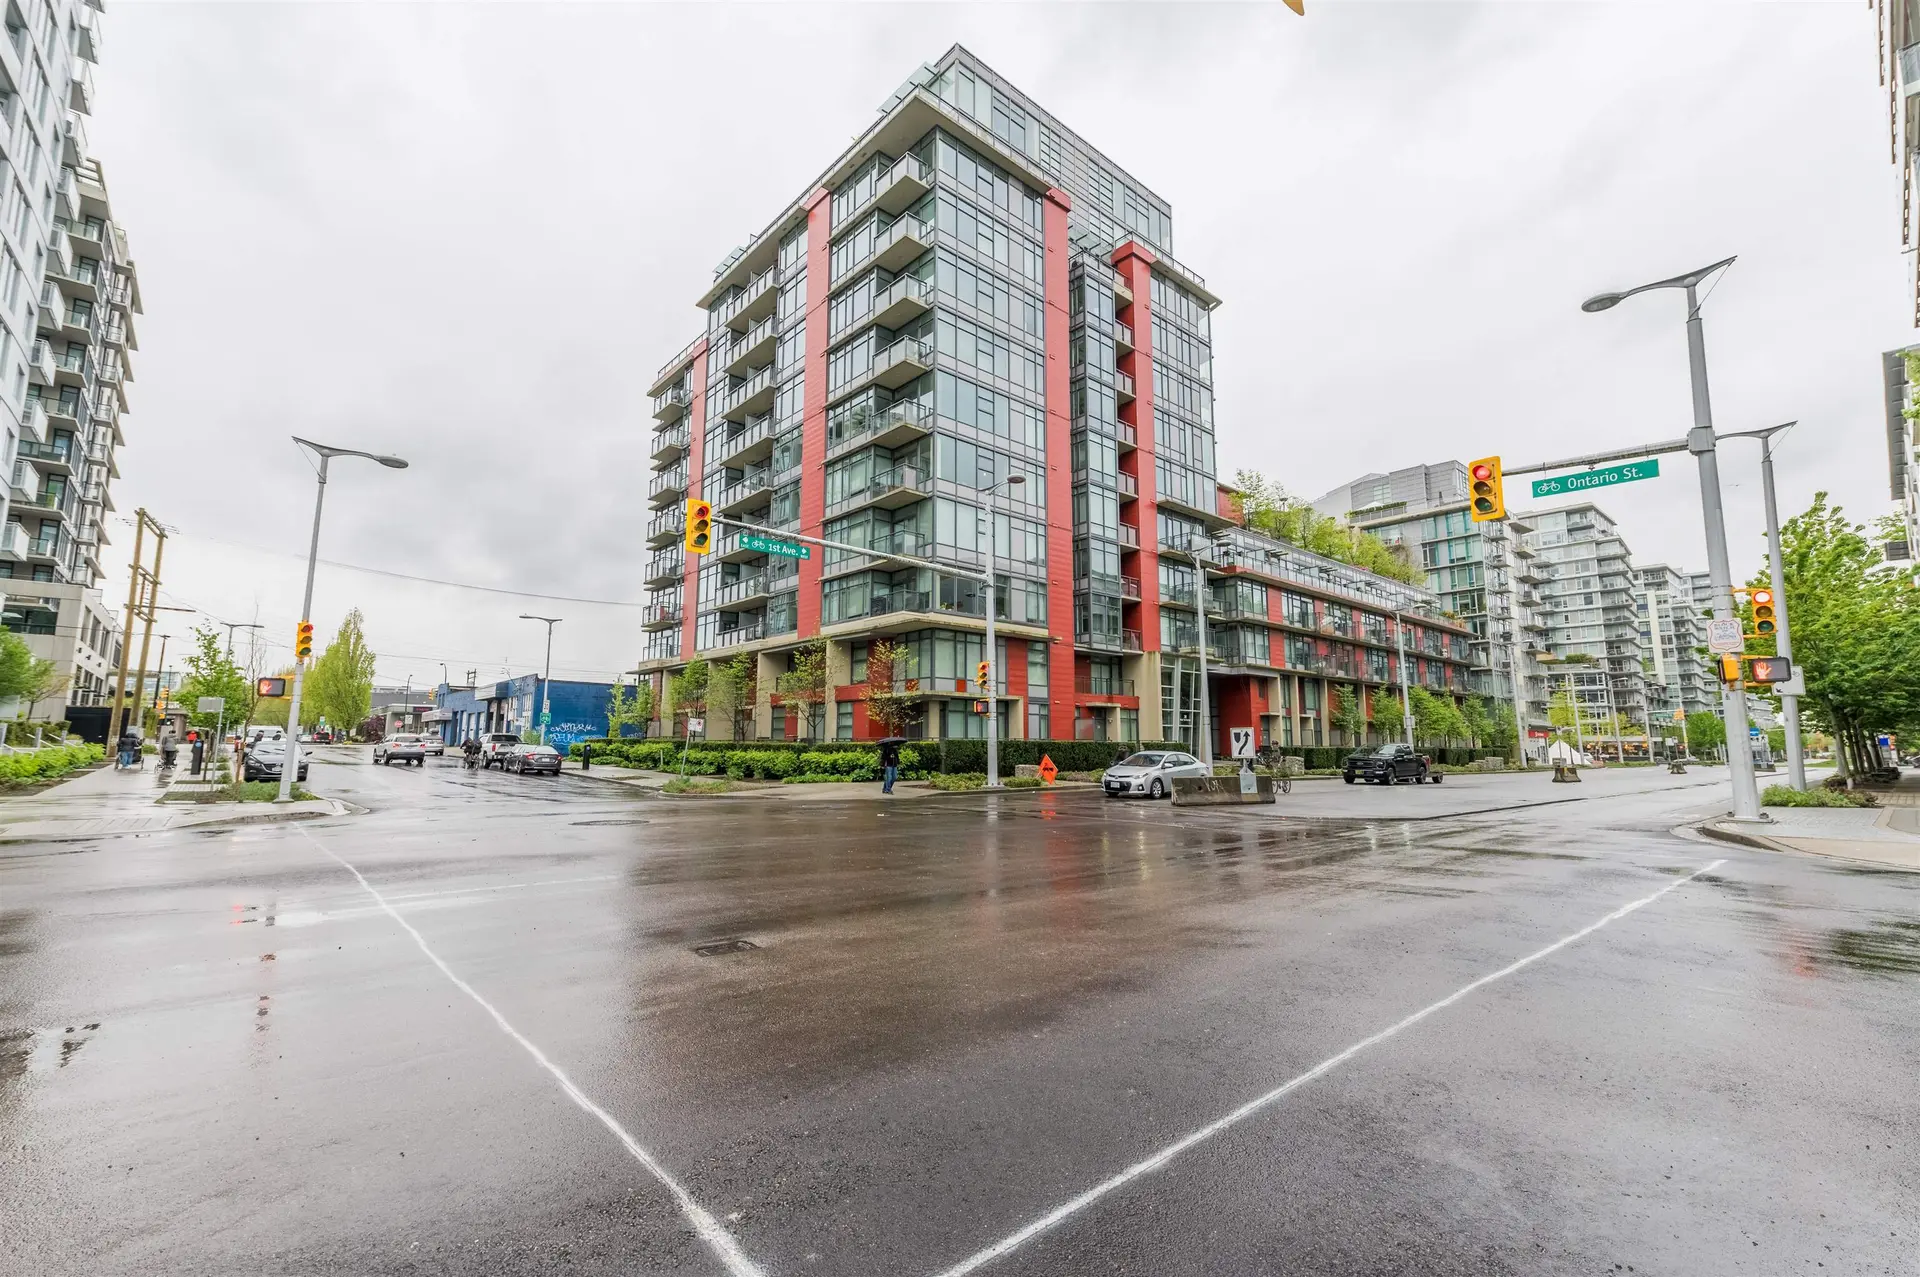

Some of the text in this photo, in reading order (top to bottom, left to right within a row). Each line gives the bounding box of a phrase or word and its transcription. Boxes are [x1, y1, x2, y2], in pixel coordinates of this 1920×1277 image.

[1567, 467, 1643, 489] Ontario St.
[768, 543, 799, 556] 1st Ave.
